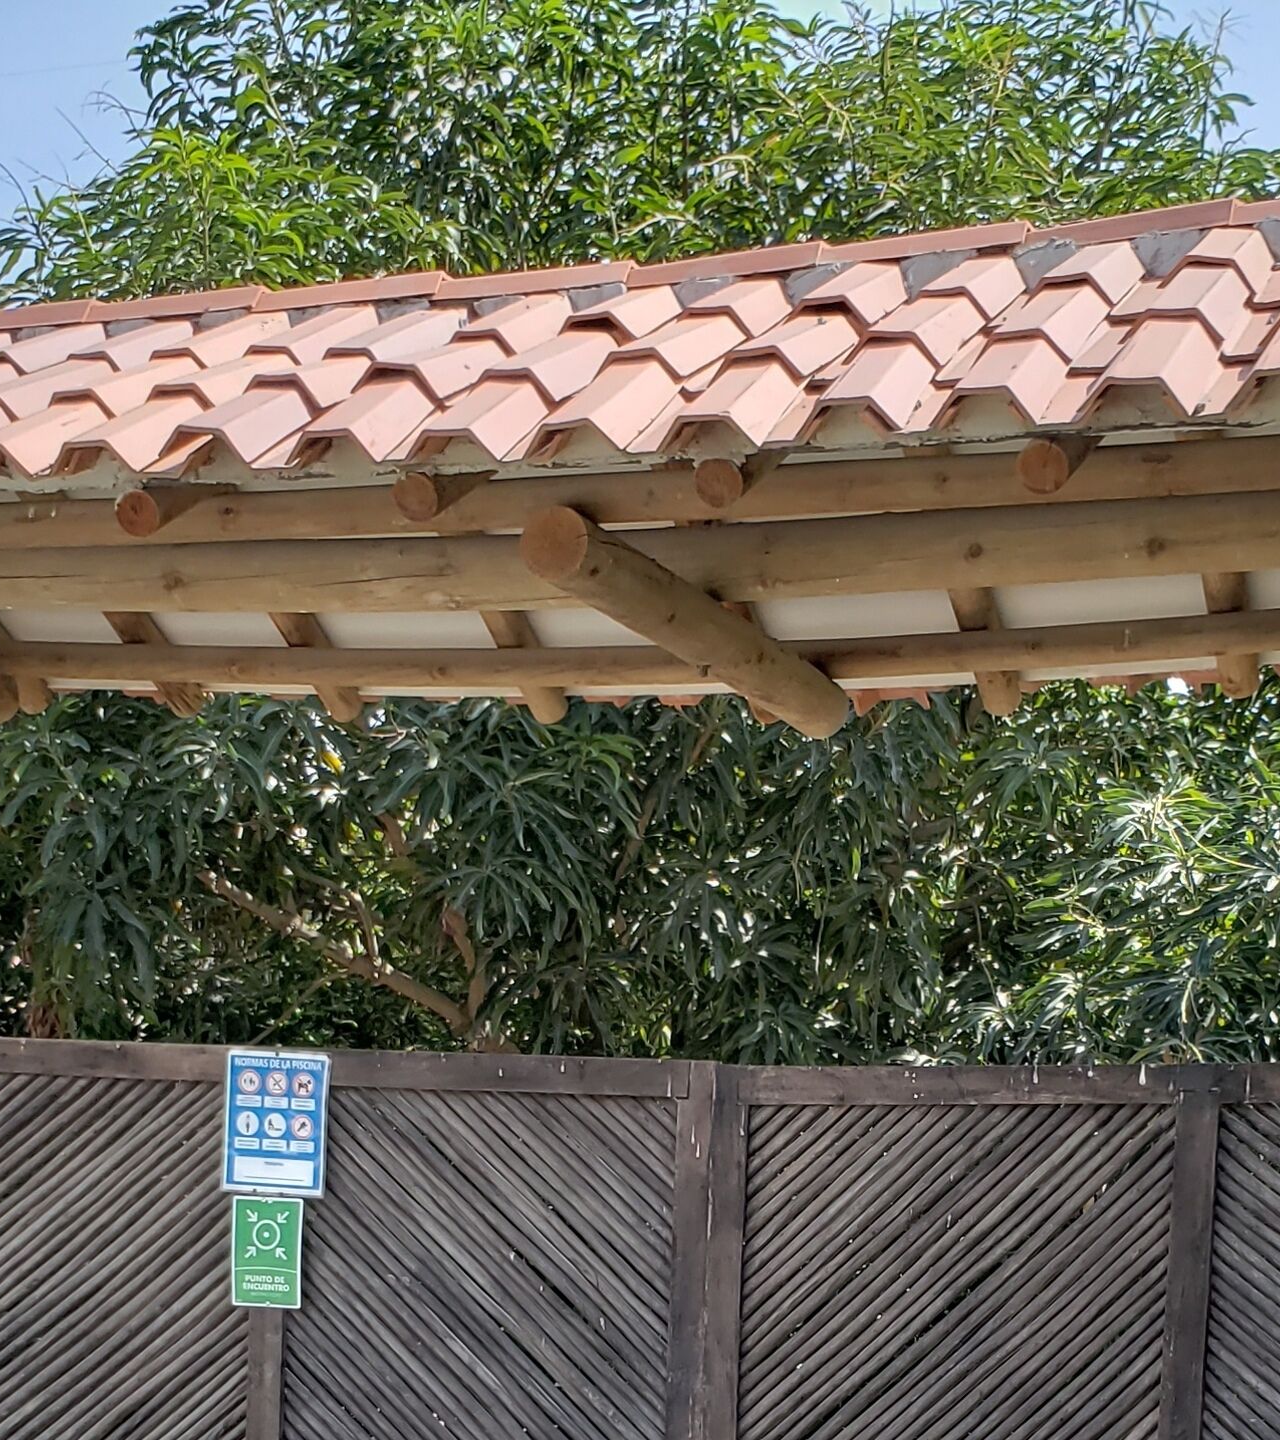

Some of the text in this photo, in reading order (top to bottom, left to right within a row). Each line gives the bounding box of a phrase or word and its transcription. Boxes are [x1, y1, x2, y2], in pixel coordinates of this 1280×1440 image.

[234, 1057, 322, 1071] NORMAS DE LA PISCINA
[244, 1274, 285, 1284] PUNTO DE
[242, 1282, 290, 1292] ENCUENTRO
